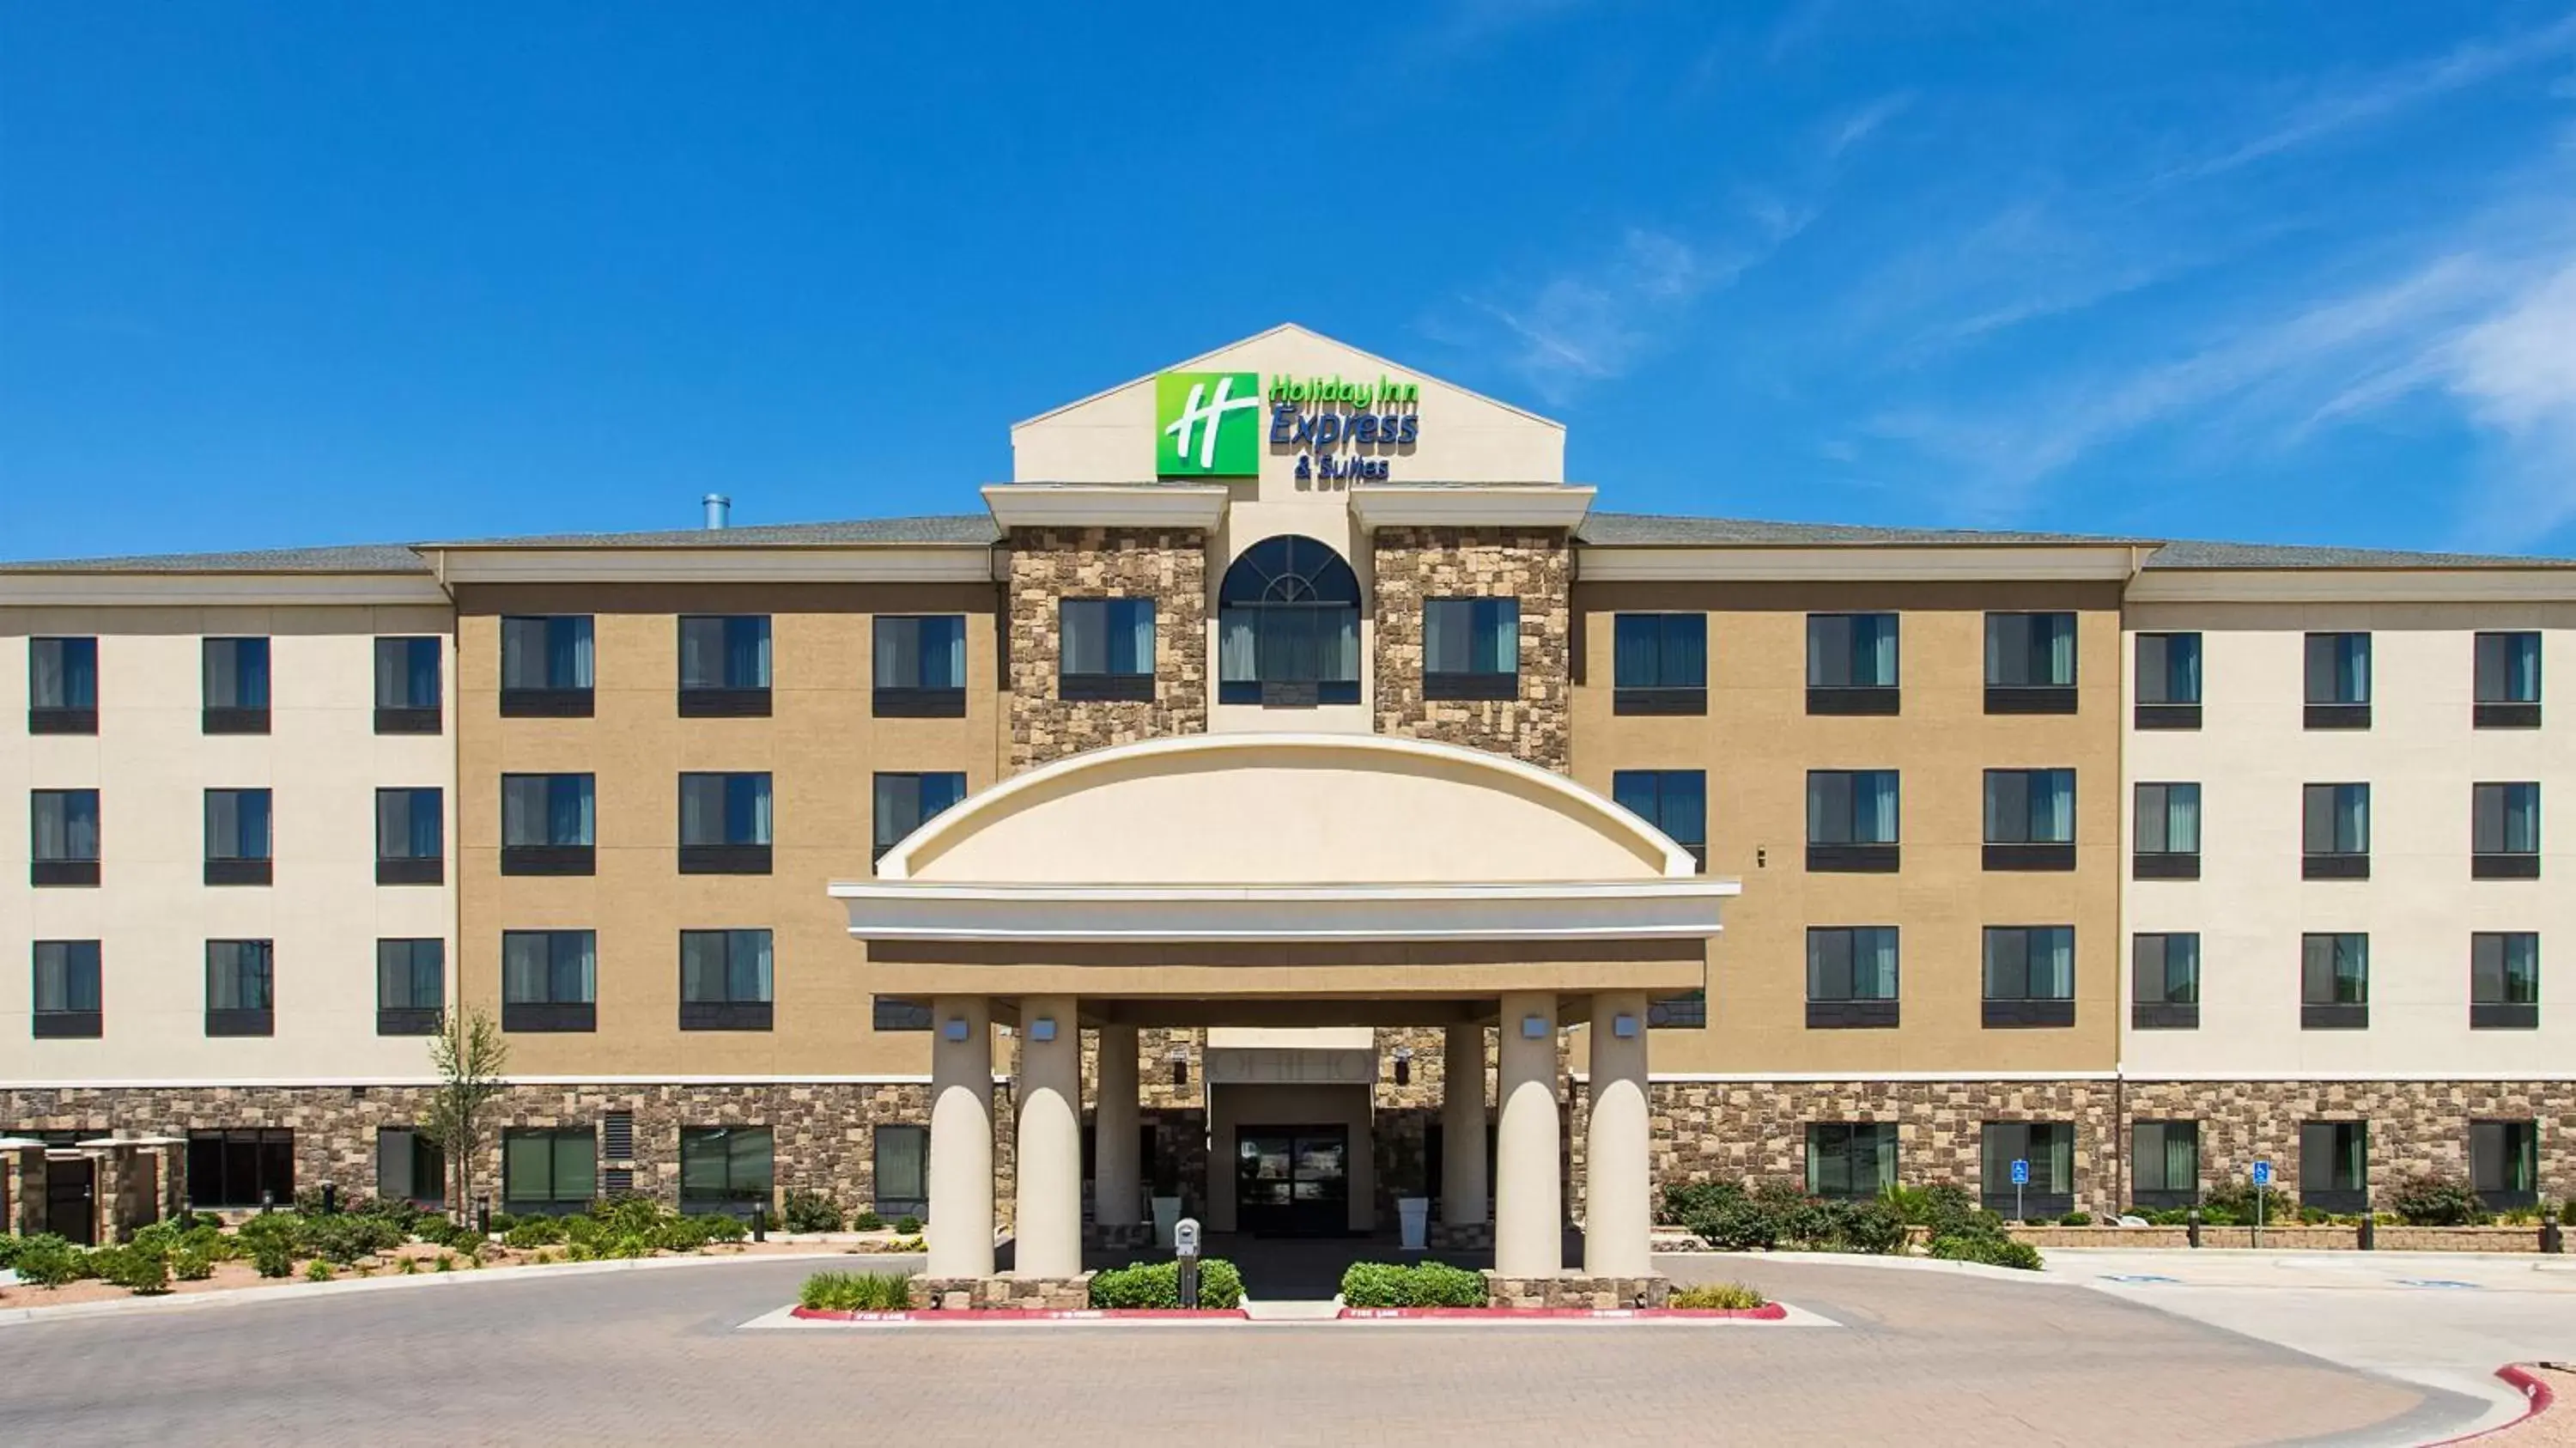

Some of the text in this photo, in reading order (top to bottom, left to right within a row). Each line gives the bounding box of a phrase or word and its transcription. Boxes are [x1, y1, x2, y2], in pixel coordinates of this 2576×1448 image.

[1269, 373, 1419, 408] Holiday Inn
[1270, 404, 1419, 453] Express
[1295, 453, 1388, 479] & Suites
